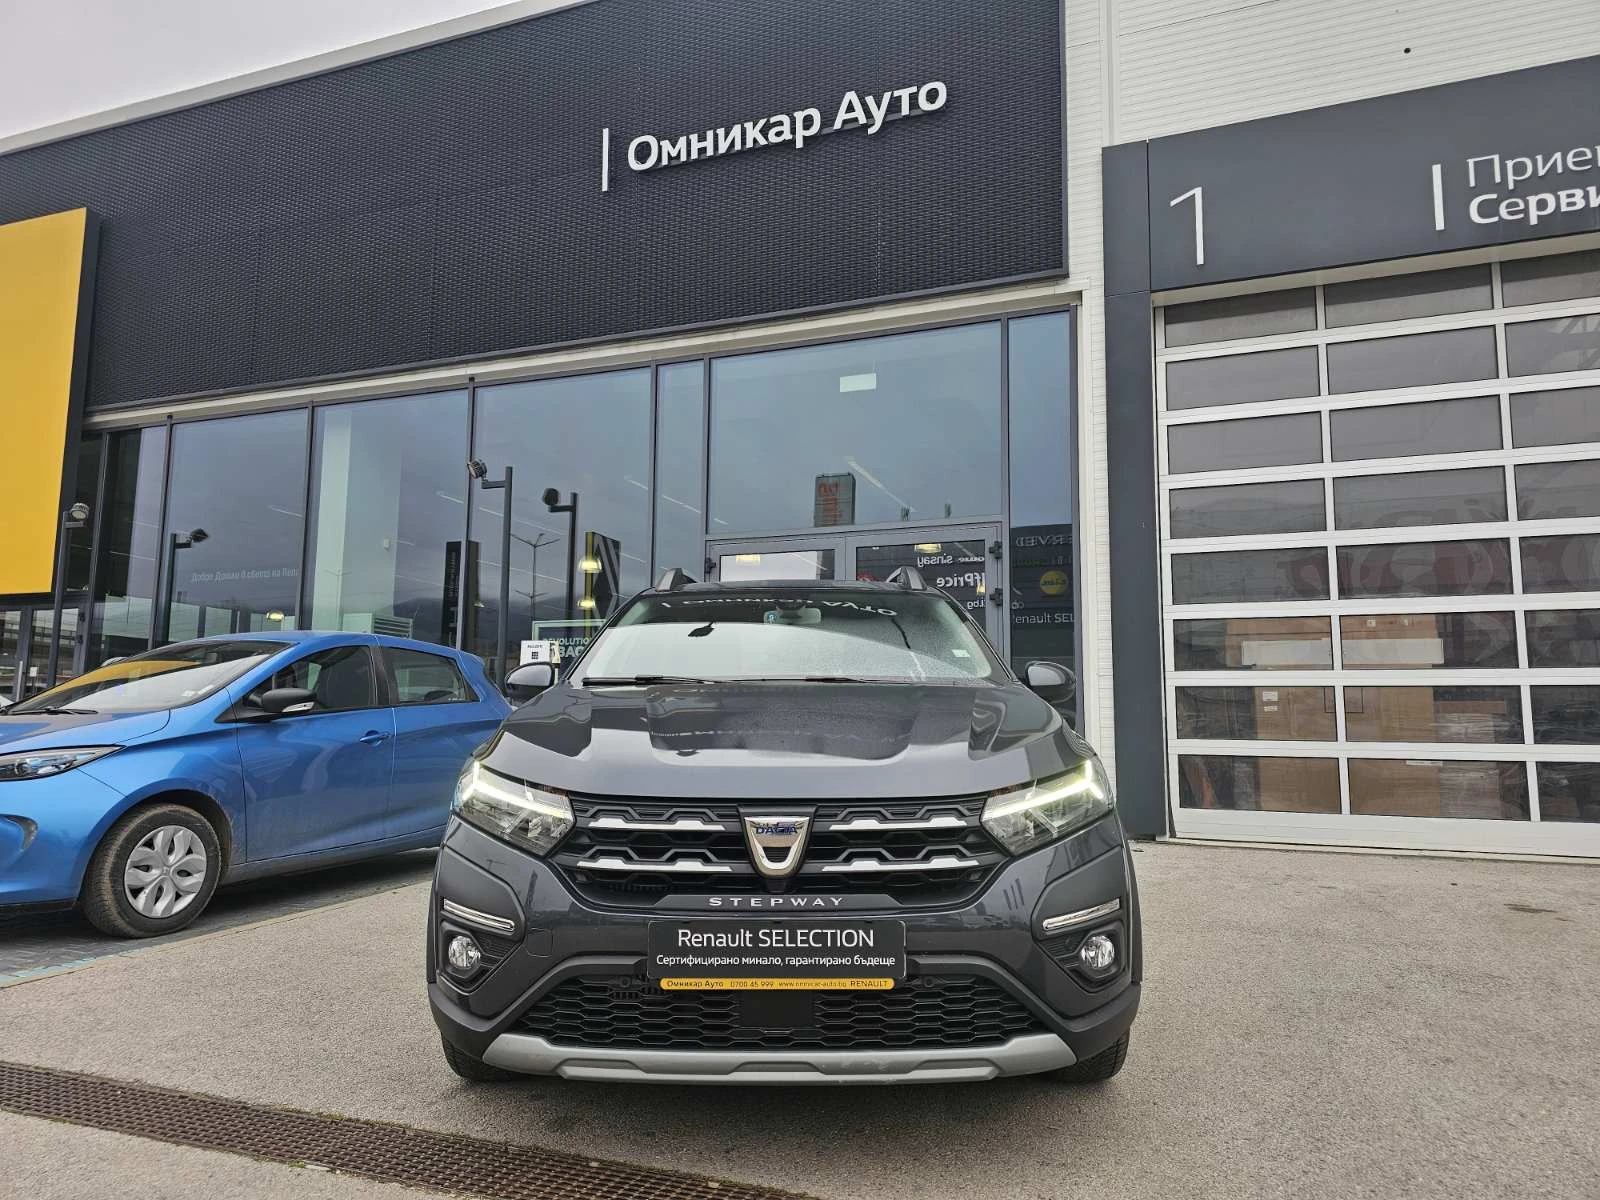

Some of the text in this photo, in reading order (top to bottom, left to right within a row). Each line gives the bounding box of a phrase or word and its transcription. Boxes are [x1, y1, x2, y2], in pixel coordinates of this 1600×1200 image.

[627, 81, 948, 171] Омникар Ауто
[1466, 145, 1600, 190] Прие
[1170, 186, 1204, 265] 1
[1013, 611, 1052, 623] enault
[756, 825, 798, 834] DACIA
[709, 897, 844, 907] STEPWAY
[677, 929, 874, 948] Renault SELECTION
[656, 954, 896, 968] Сертифицирано минало, гарантирано бъдеще
[667, 980, 703, 988] Омникар
[704, 980, 724, 988] Ауто
